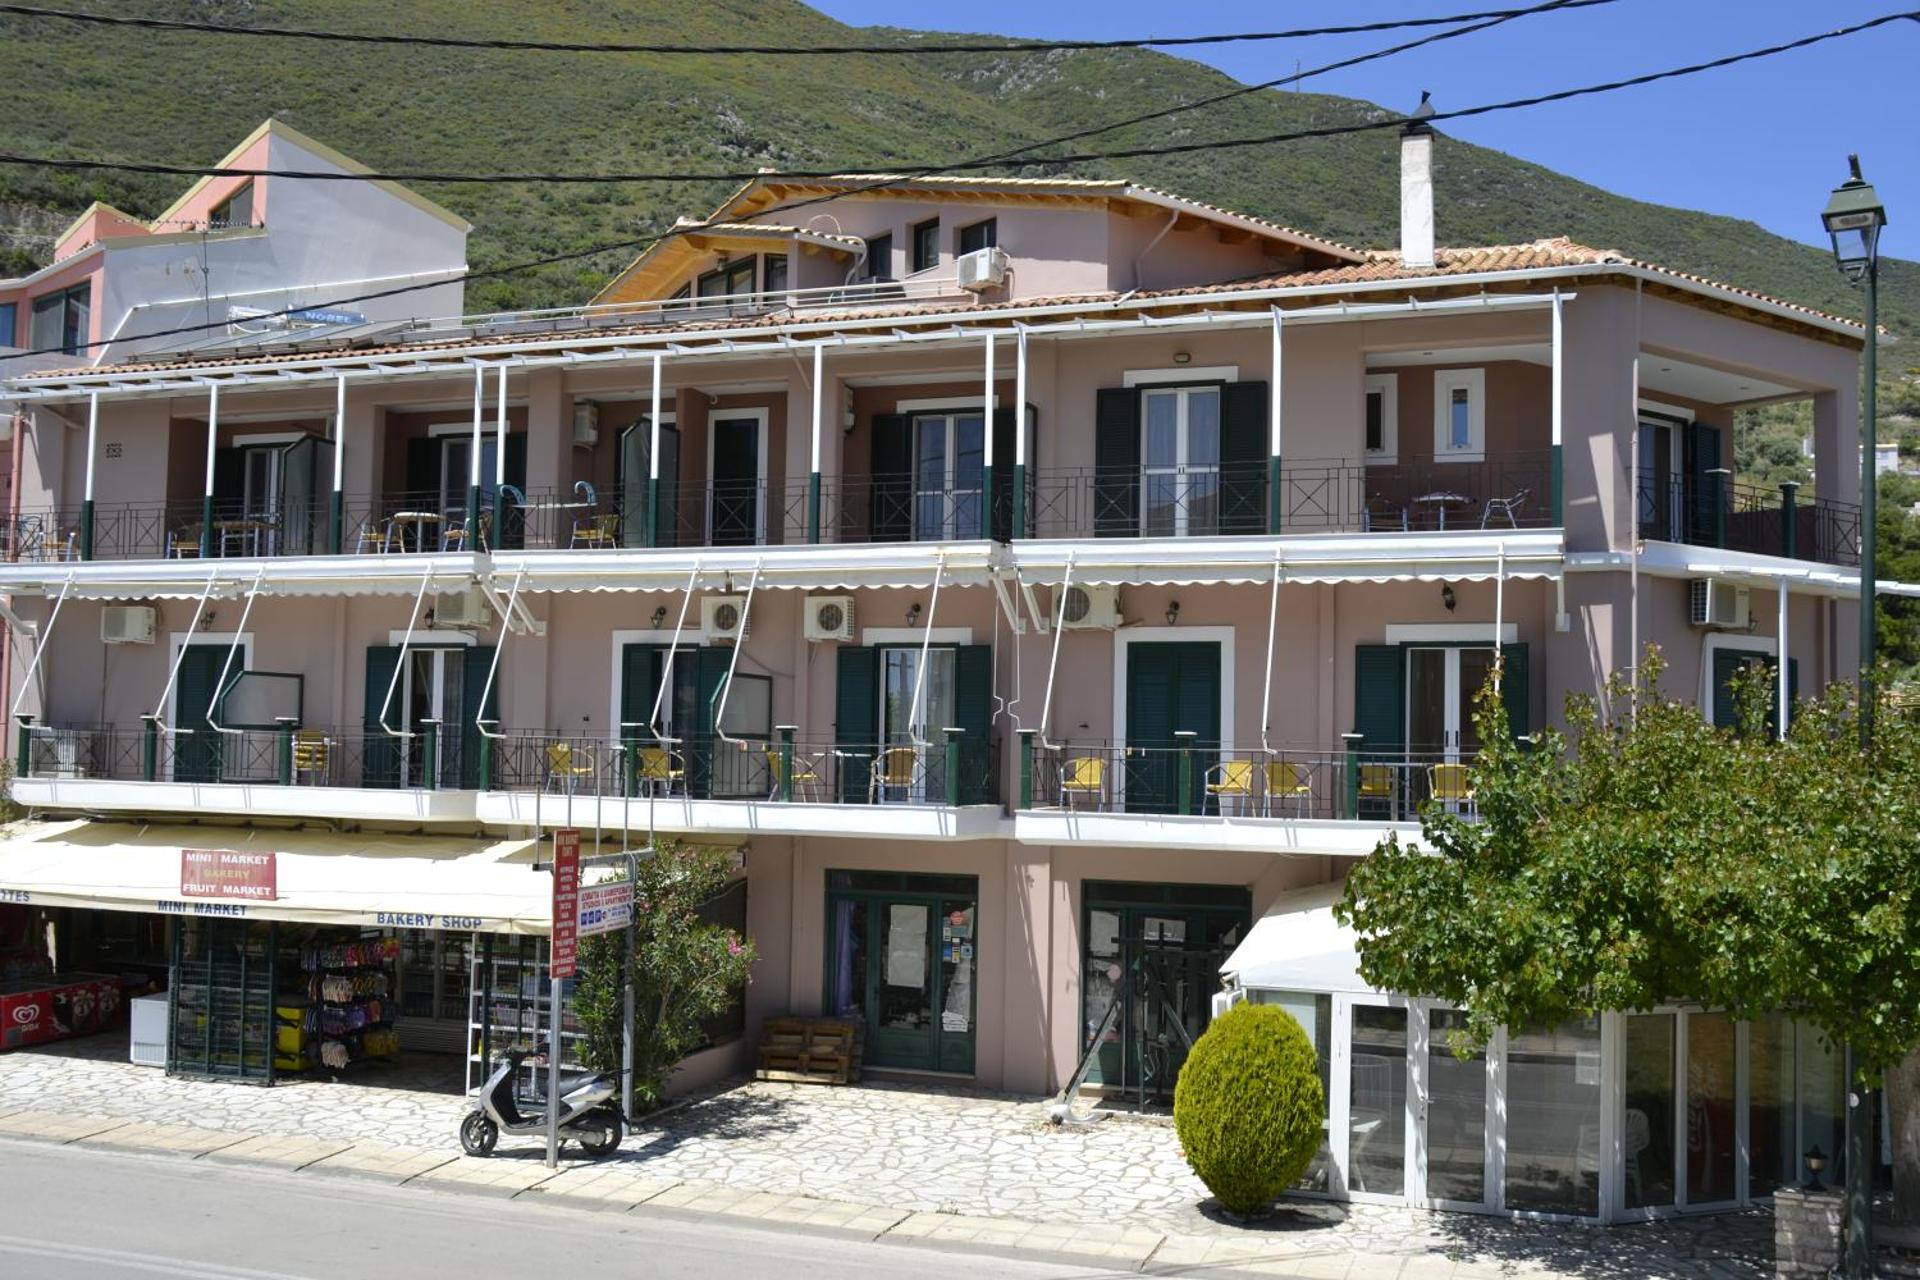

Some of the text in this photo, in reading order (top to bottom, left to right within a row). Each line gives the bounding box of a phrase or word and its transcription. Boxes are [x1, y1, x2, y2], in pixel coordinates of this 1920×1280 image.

[305, 311, 352, 323] NOBEL
[186, 853, 270, 865] MINI MARKET
[203, 868, 250, 879] BAKERY
[183, 883, 272, 896] FRUIT MARKET
[157, 900, 248, 916] MINI MARKET
[377, 912, 482, 929] BAKERY SHOP
